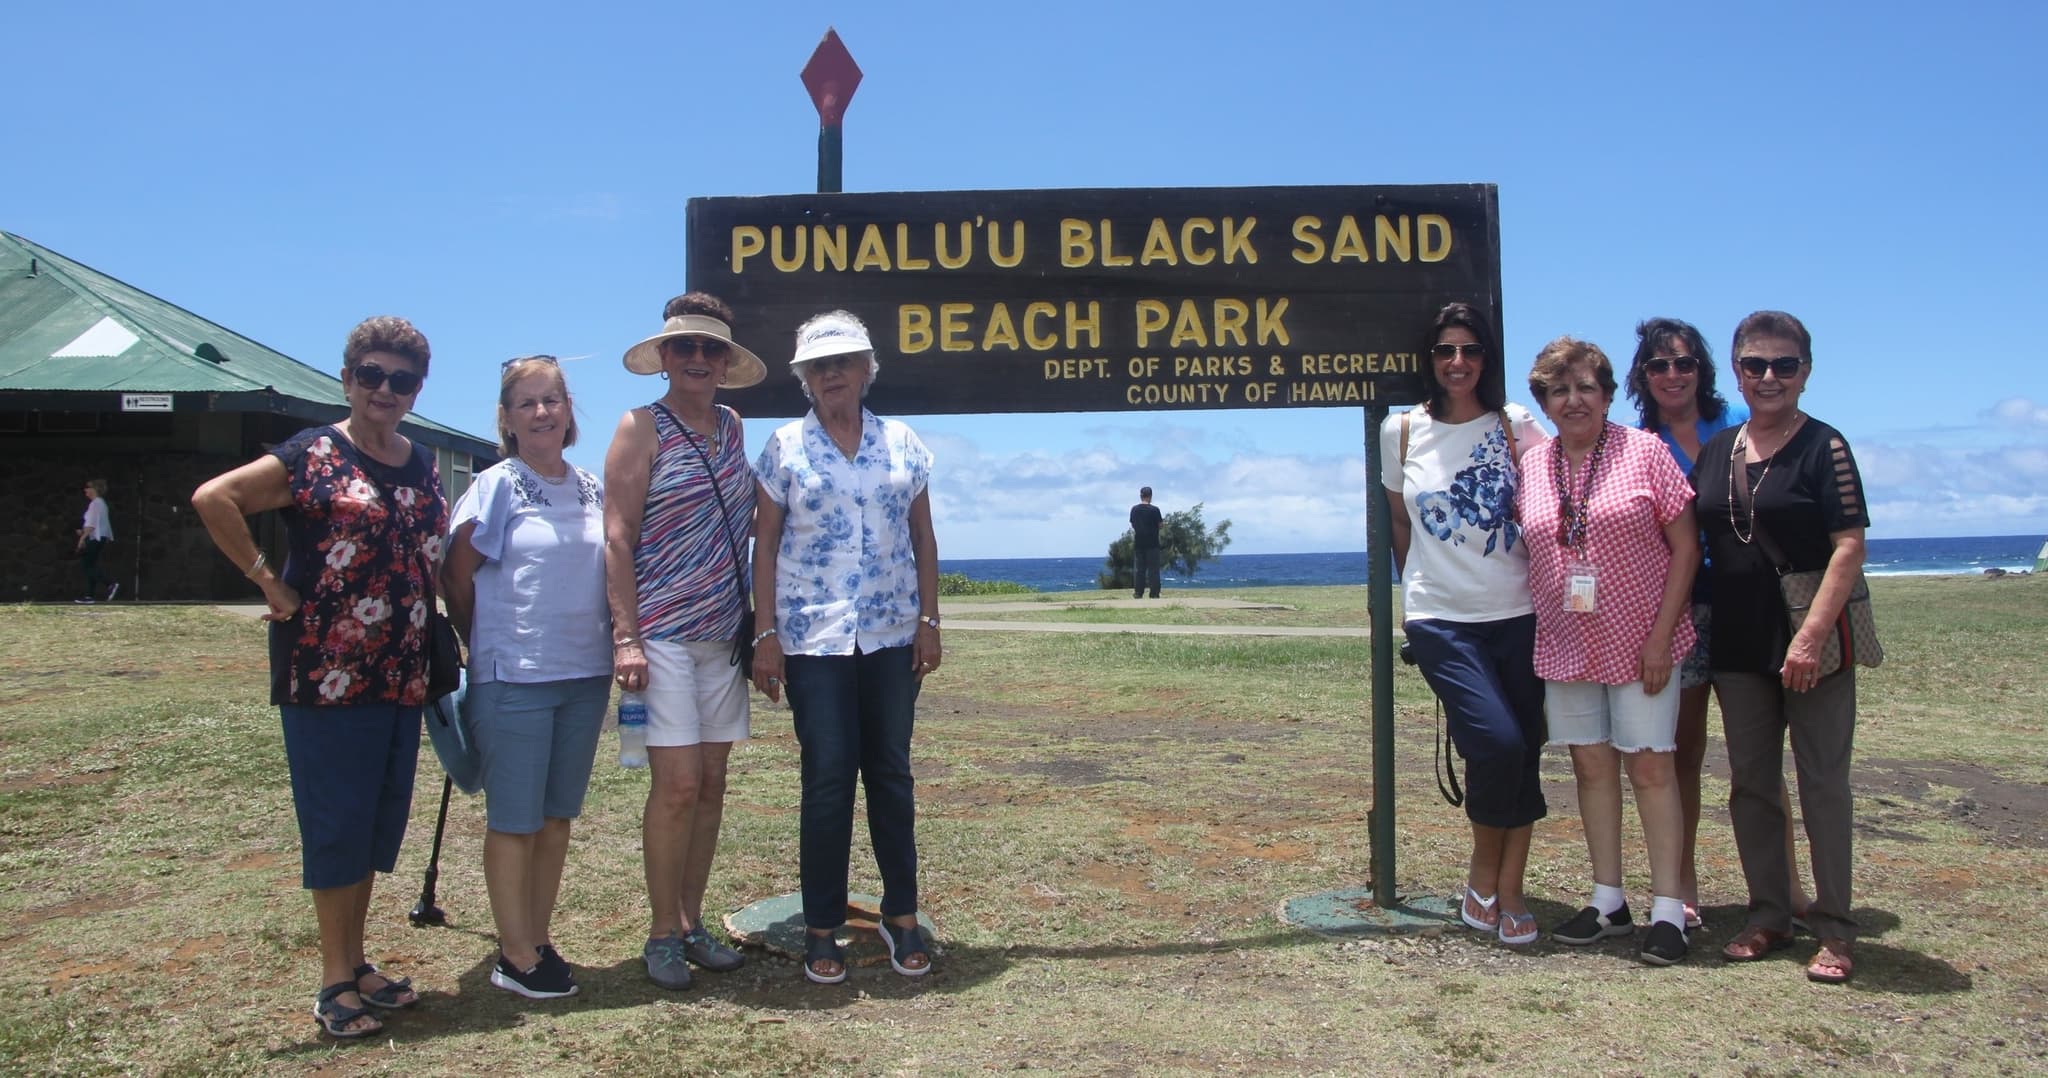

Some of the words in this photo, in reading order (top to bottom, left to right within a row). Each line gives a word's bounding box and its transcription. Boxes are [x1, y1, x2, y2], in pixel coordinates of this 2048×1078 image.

[732, 215, 1025, 273] PUNALU'U
[1060, 217, 1258, 268] BLACK
[1291, 214, 1452, 264] SAND
[899, 302, 1101, 354] BEACH
[1136, 297, 1291, 349] PARK
[1044, 358, 1111, 380] DEPT.
[1128, 357, 1161, 378] OF
[1174, 355, 1253, 377] PARKS
[1269, 355, 1285, 375] &
[1126, 383, 1229, 404] COUNTY
[1245, 382, 1278, 402] OF
[1292, 381, 1375, 402] HAWAII
